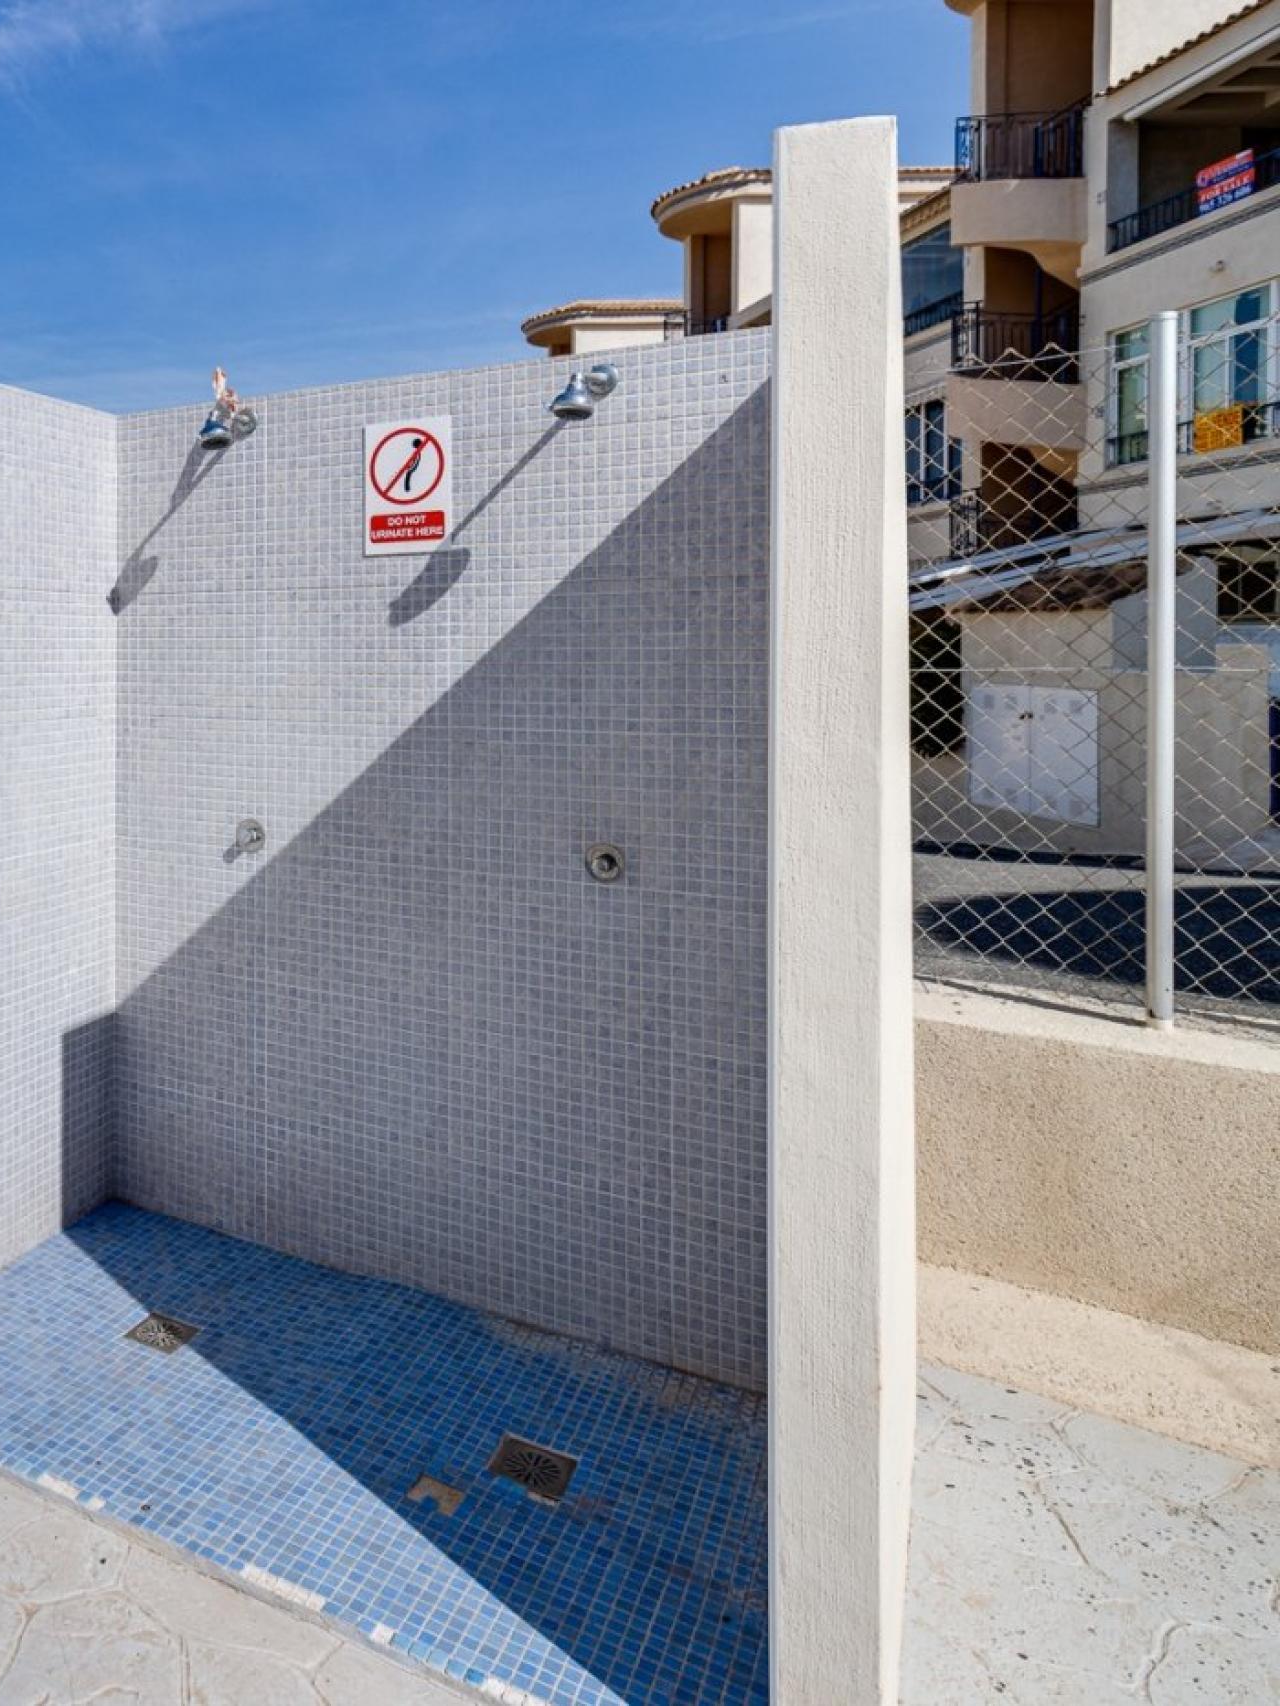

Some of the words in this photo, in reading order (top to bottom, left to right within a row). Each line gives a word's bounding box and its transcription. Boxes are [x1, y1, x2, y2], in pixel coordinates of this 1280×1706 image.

[387, 516, 403, 526] DO
[405, 515, 426, 525] NOT
[372, 528, 414, 540] URINATE
[415, 526, 443, 536] HERE
